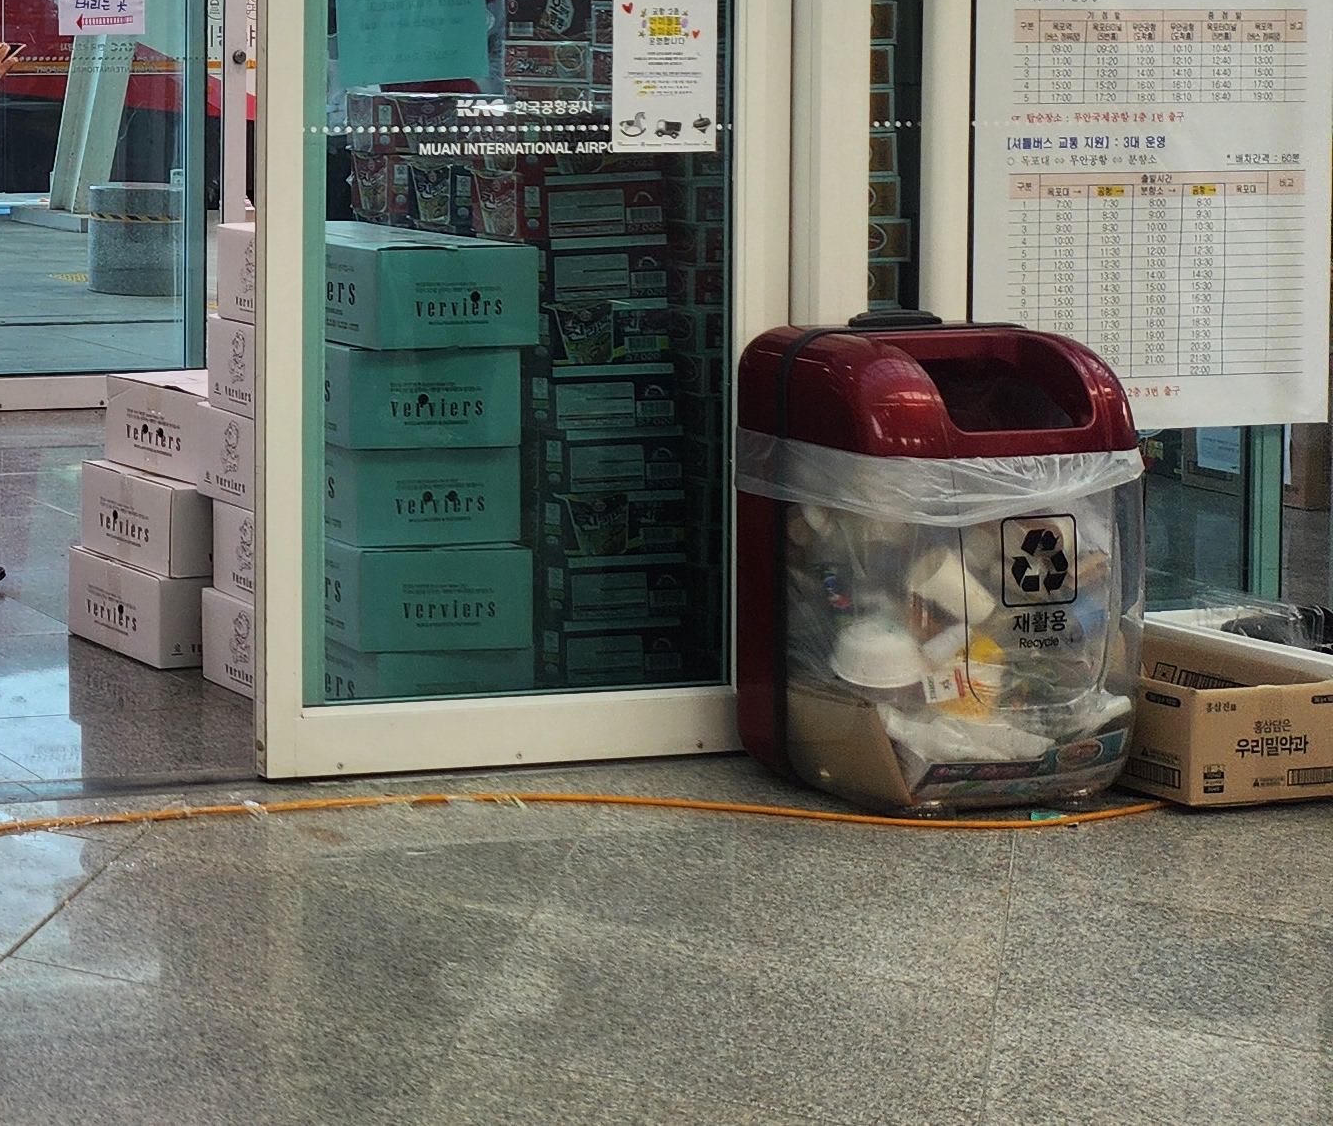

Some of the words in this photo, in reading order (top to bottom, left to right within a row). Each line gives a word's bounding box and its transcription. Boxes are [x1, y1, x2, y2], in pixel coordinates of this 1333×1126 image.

[514, 99, 593, 115] 한국공항공사
[419, 142, 460, 156] MUAN
[464, 141, 572, 155] INTERNATIONAL
[1058, 137, 1079, 149] 교통
[1145, 136, 1166, 149] 운영
[416, 297, 502, 317] verviers
[390, 398, 484, 417] verviers
[403, 599, 496, 619] verviers
[1012, 610, 1068, 633] 재활용
[1019, 636, 1060, 649] Recycle
[1235, 735, 1309, 758] 우리밀약과
